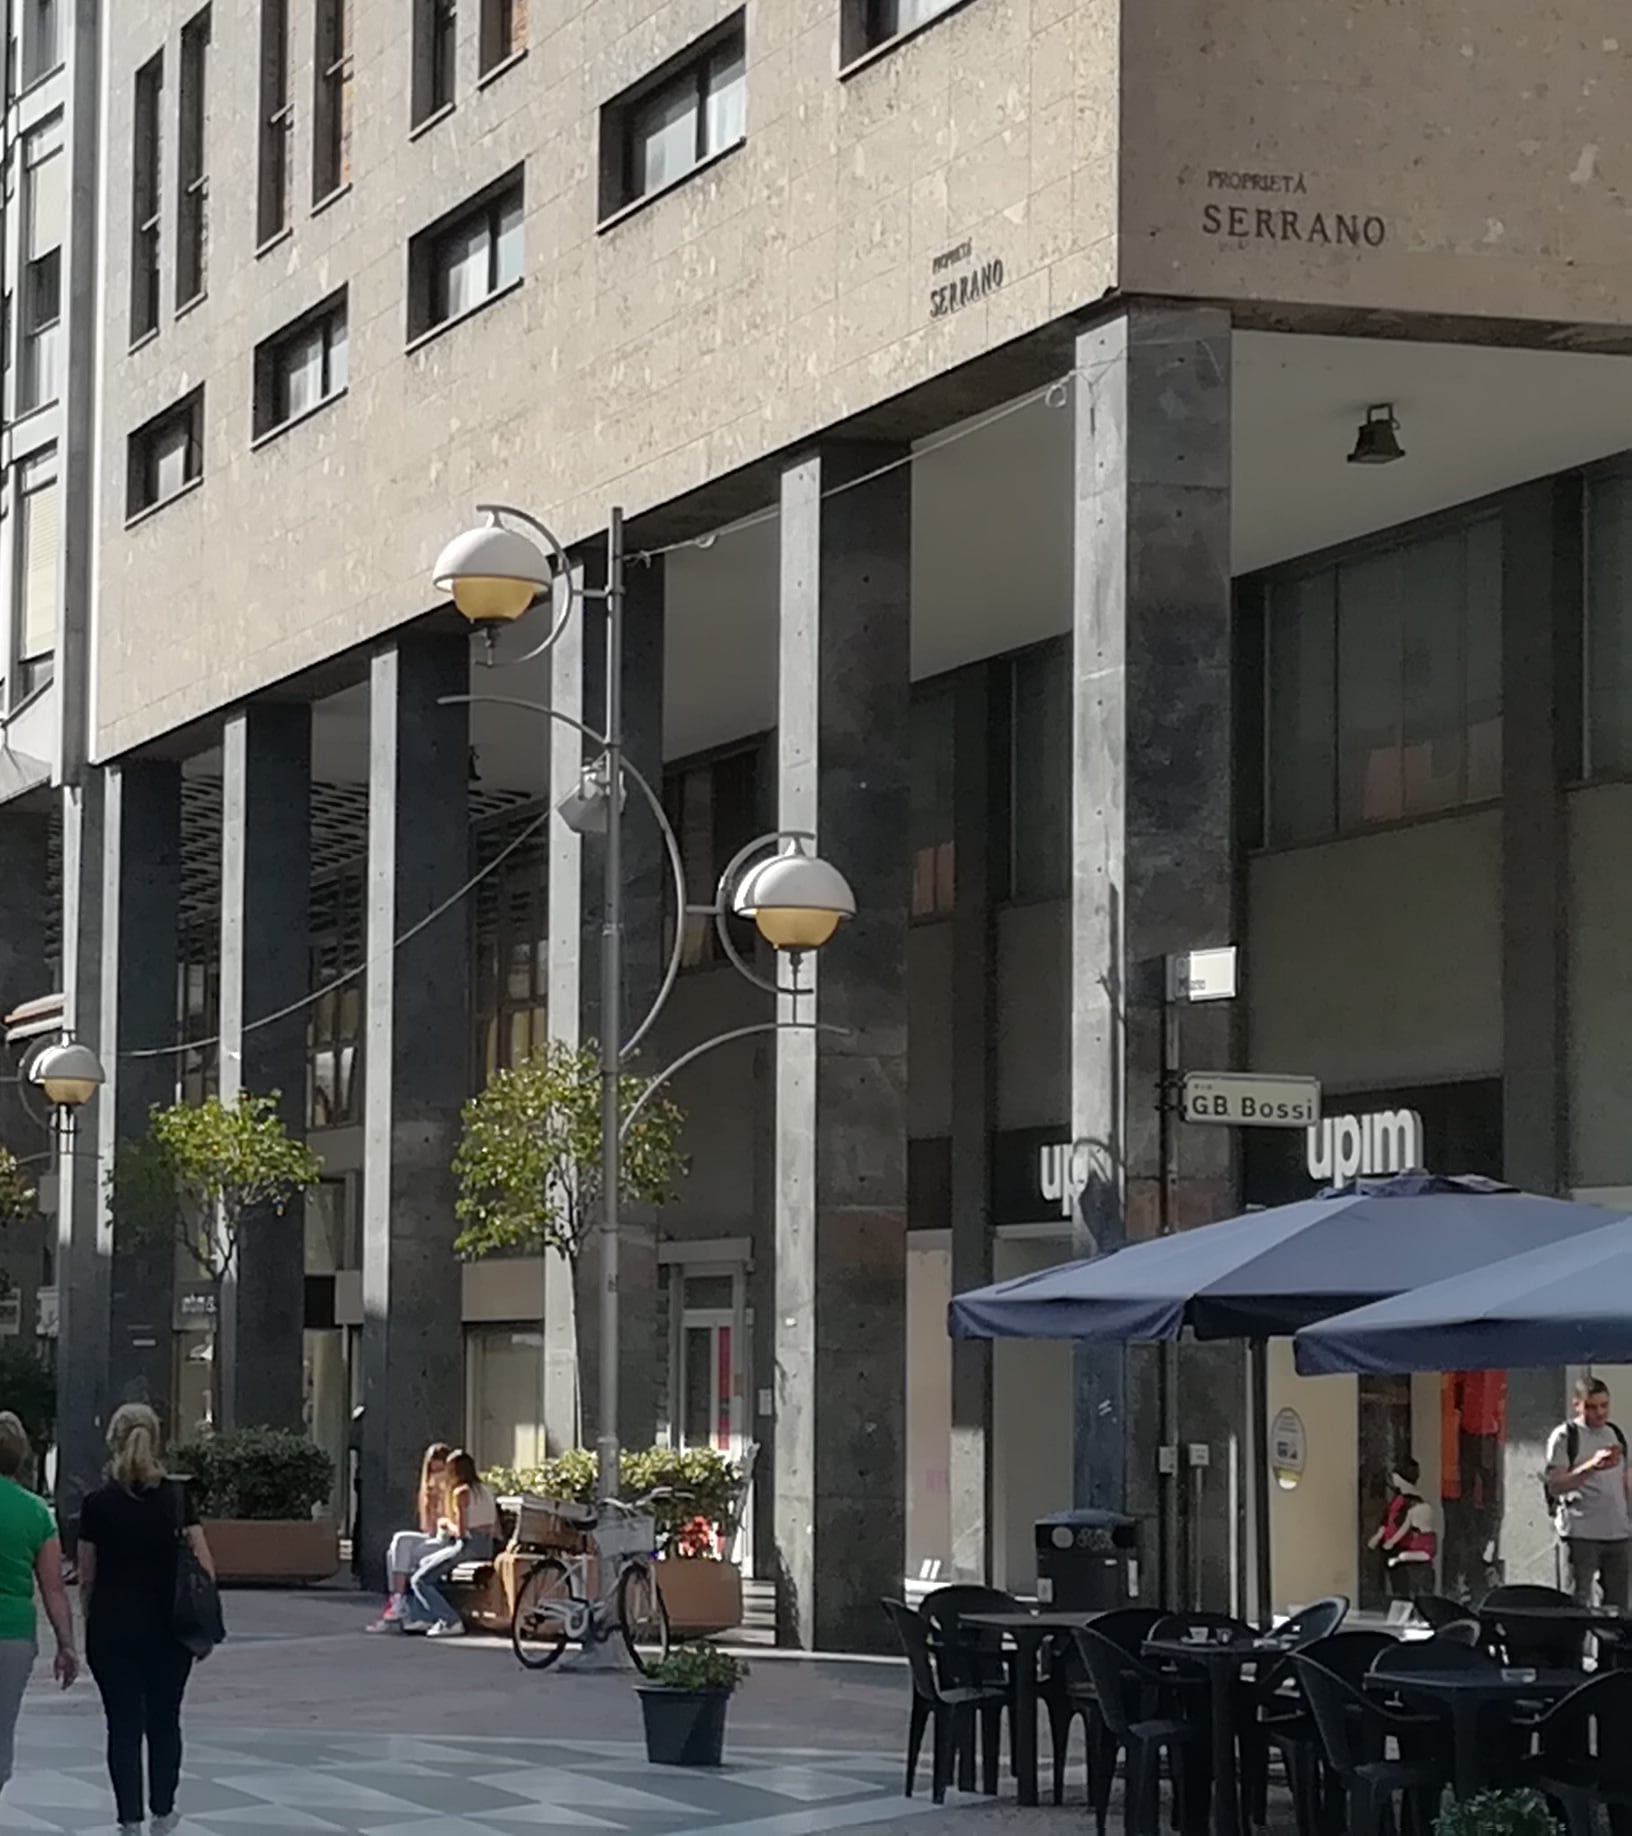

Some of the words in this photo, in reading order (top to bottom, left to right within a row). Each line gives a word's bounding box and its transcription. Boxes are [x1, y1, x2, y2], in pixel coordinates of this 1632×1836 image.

[1202, 204, 1385, 247] SERRANO
[930, 258, 1004, 318] SERRANO
[1241, 1097, 1312, 1120] Bossi
[1307, 1108, 1422, 1189] upim
